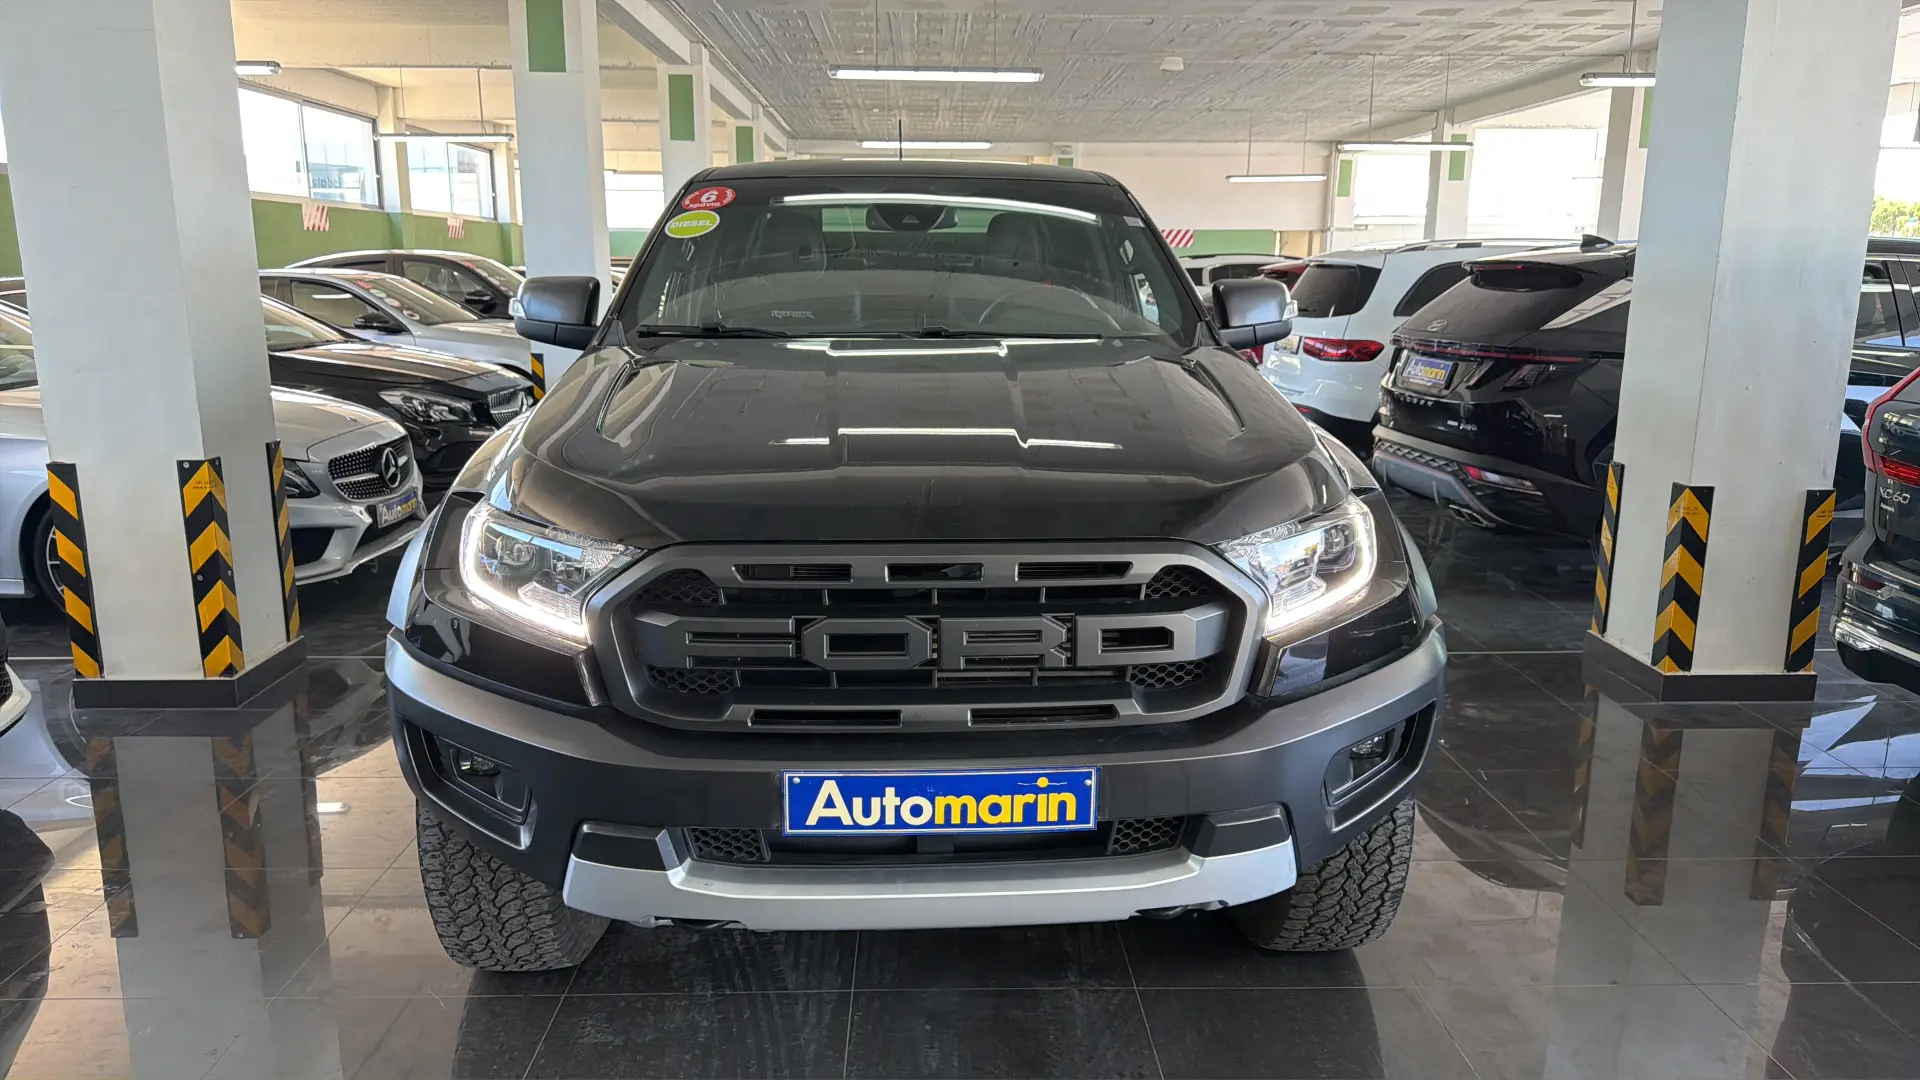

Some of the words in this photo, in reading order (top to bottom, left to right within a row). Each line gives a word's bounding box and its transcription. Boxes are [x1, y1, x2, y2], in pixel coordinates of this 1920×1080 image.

[700, 190, 719, 202] 6
[670, 219, 713, 229] DIESEL
[657, 612, 1205, 672] FORD
[804, 776, 1077, 827] Automarin
